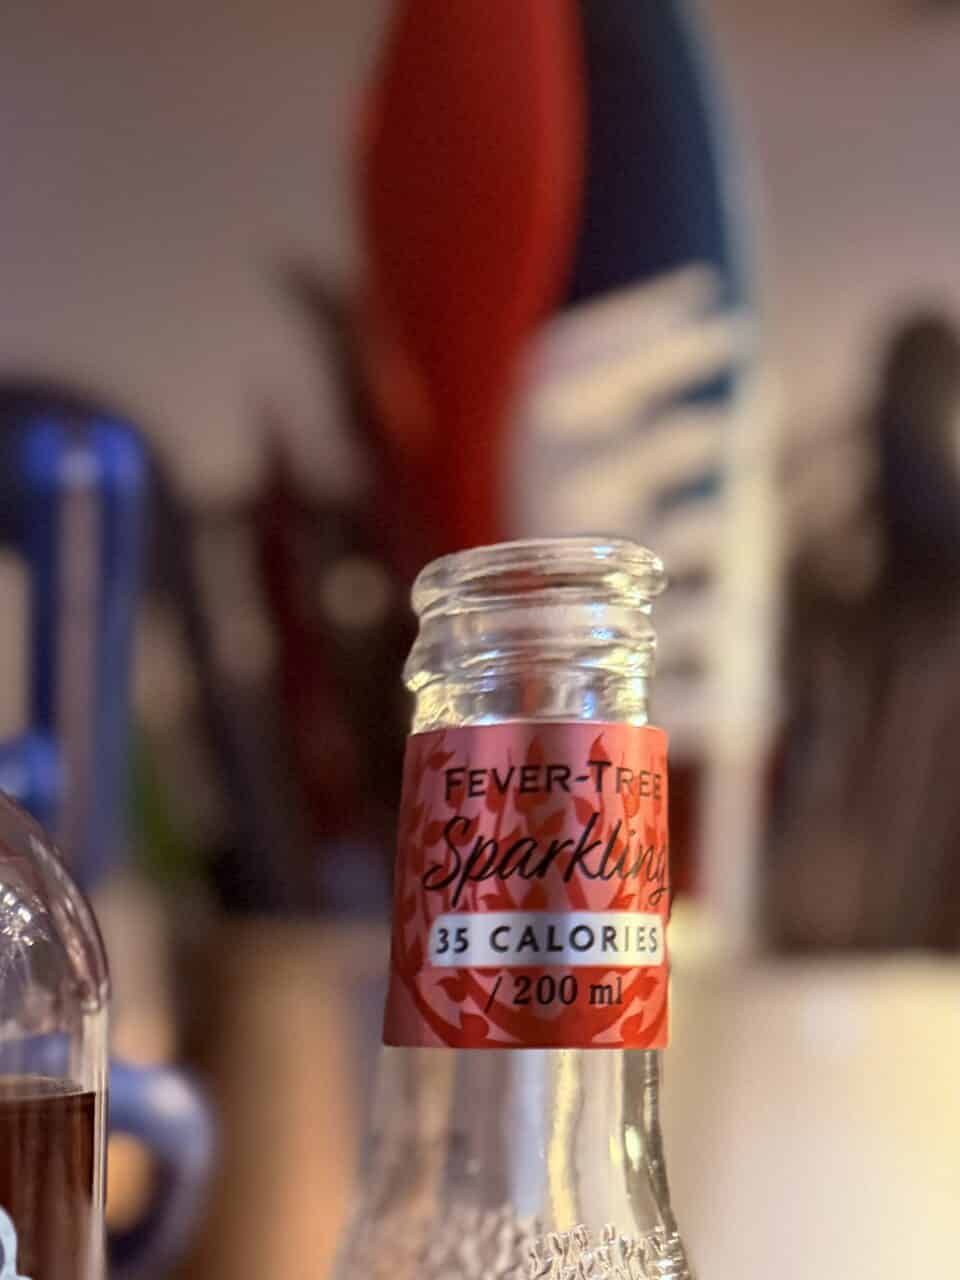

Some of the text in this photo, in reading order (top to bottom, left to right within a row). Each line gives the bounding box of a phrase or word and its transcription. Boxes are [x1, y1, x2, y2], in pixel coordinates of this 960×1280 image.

[445, 759, 663, 801] FEVER-TREE
[422, 812, 670, 908] Sparkling
[435, 925, 658, 954] 35 CALORIES
[512, 975, 578, 1006] 200
[588, 976, 623, 1006] ml
